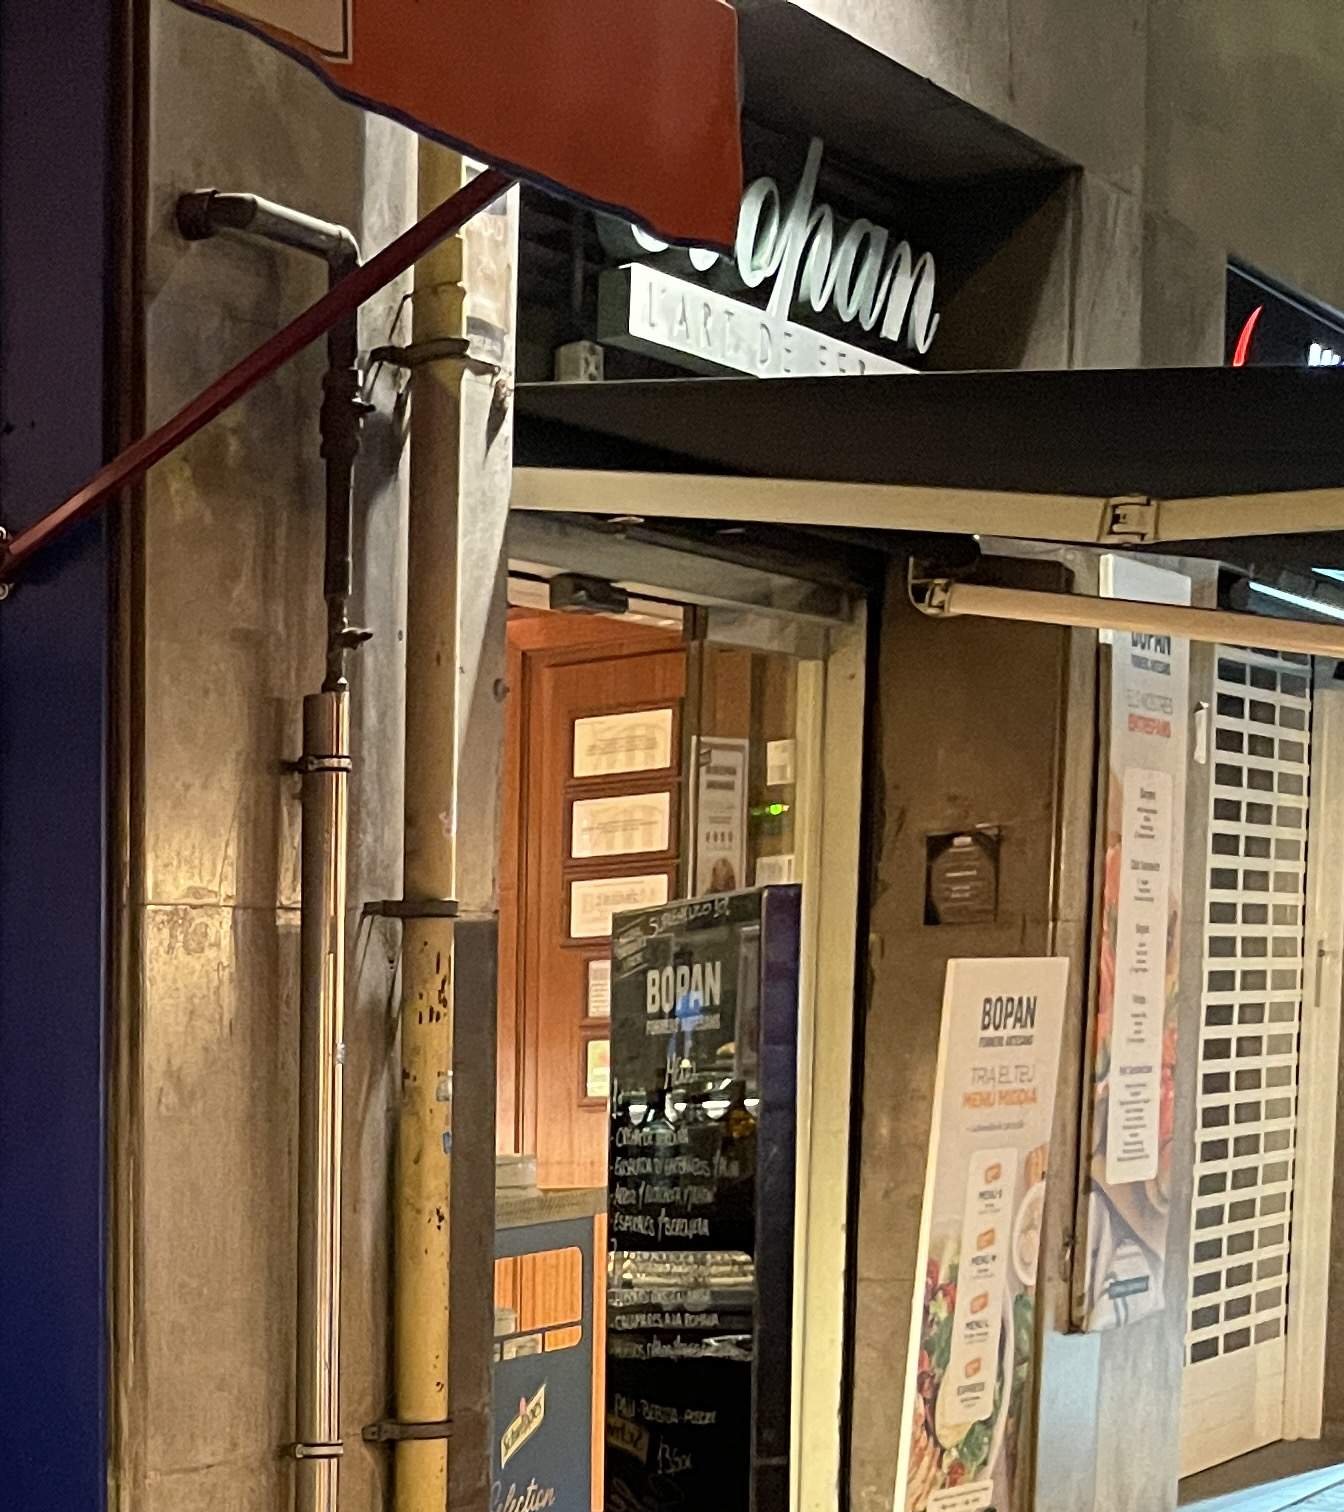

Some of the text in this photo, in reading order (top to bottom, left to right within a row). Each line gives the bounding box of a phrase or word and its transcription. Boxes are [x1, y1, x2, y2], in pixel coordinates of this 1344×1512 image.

[759, 322, 793, 374] DE
[646, 961, 722, 1014] BOPAN
[980, 994, 1038, 1031] BOPAN
